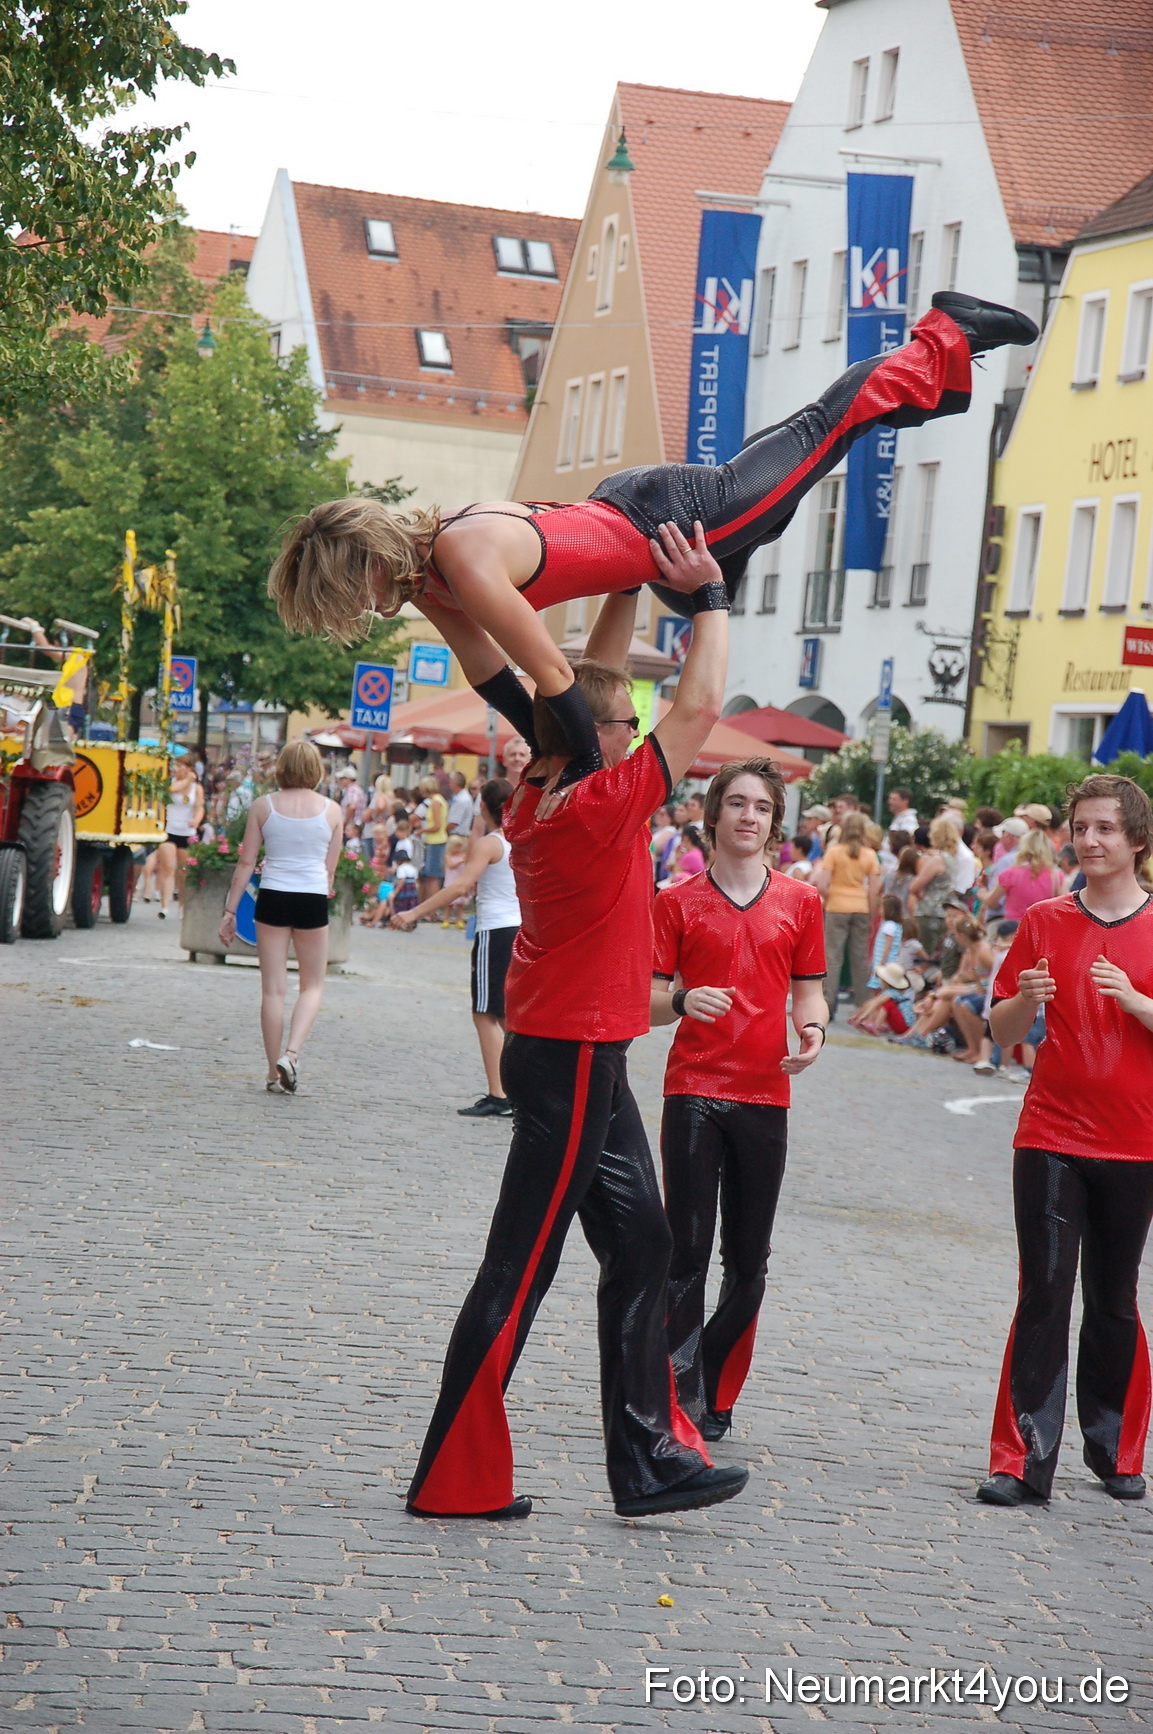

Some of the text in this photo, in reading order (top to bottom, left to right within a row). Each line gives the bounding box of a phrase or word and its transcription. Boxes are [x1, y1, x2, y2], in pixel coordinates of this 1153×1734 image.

[1088, 437, 1138, 482] HOTEL
[1062, 661, 1133, 693] Restaurant
[355, 707, 388, 727] TAXI
